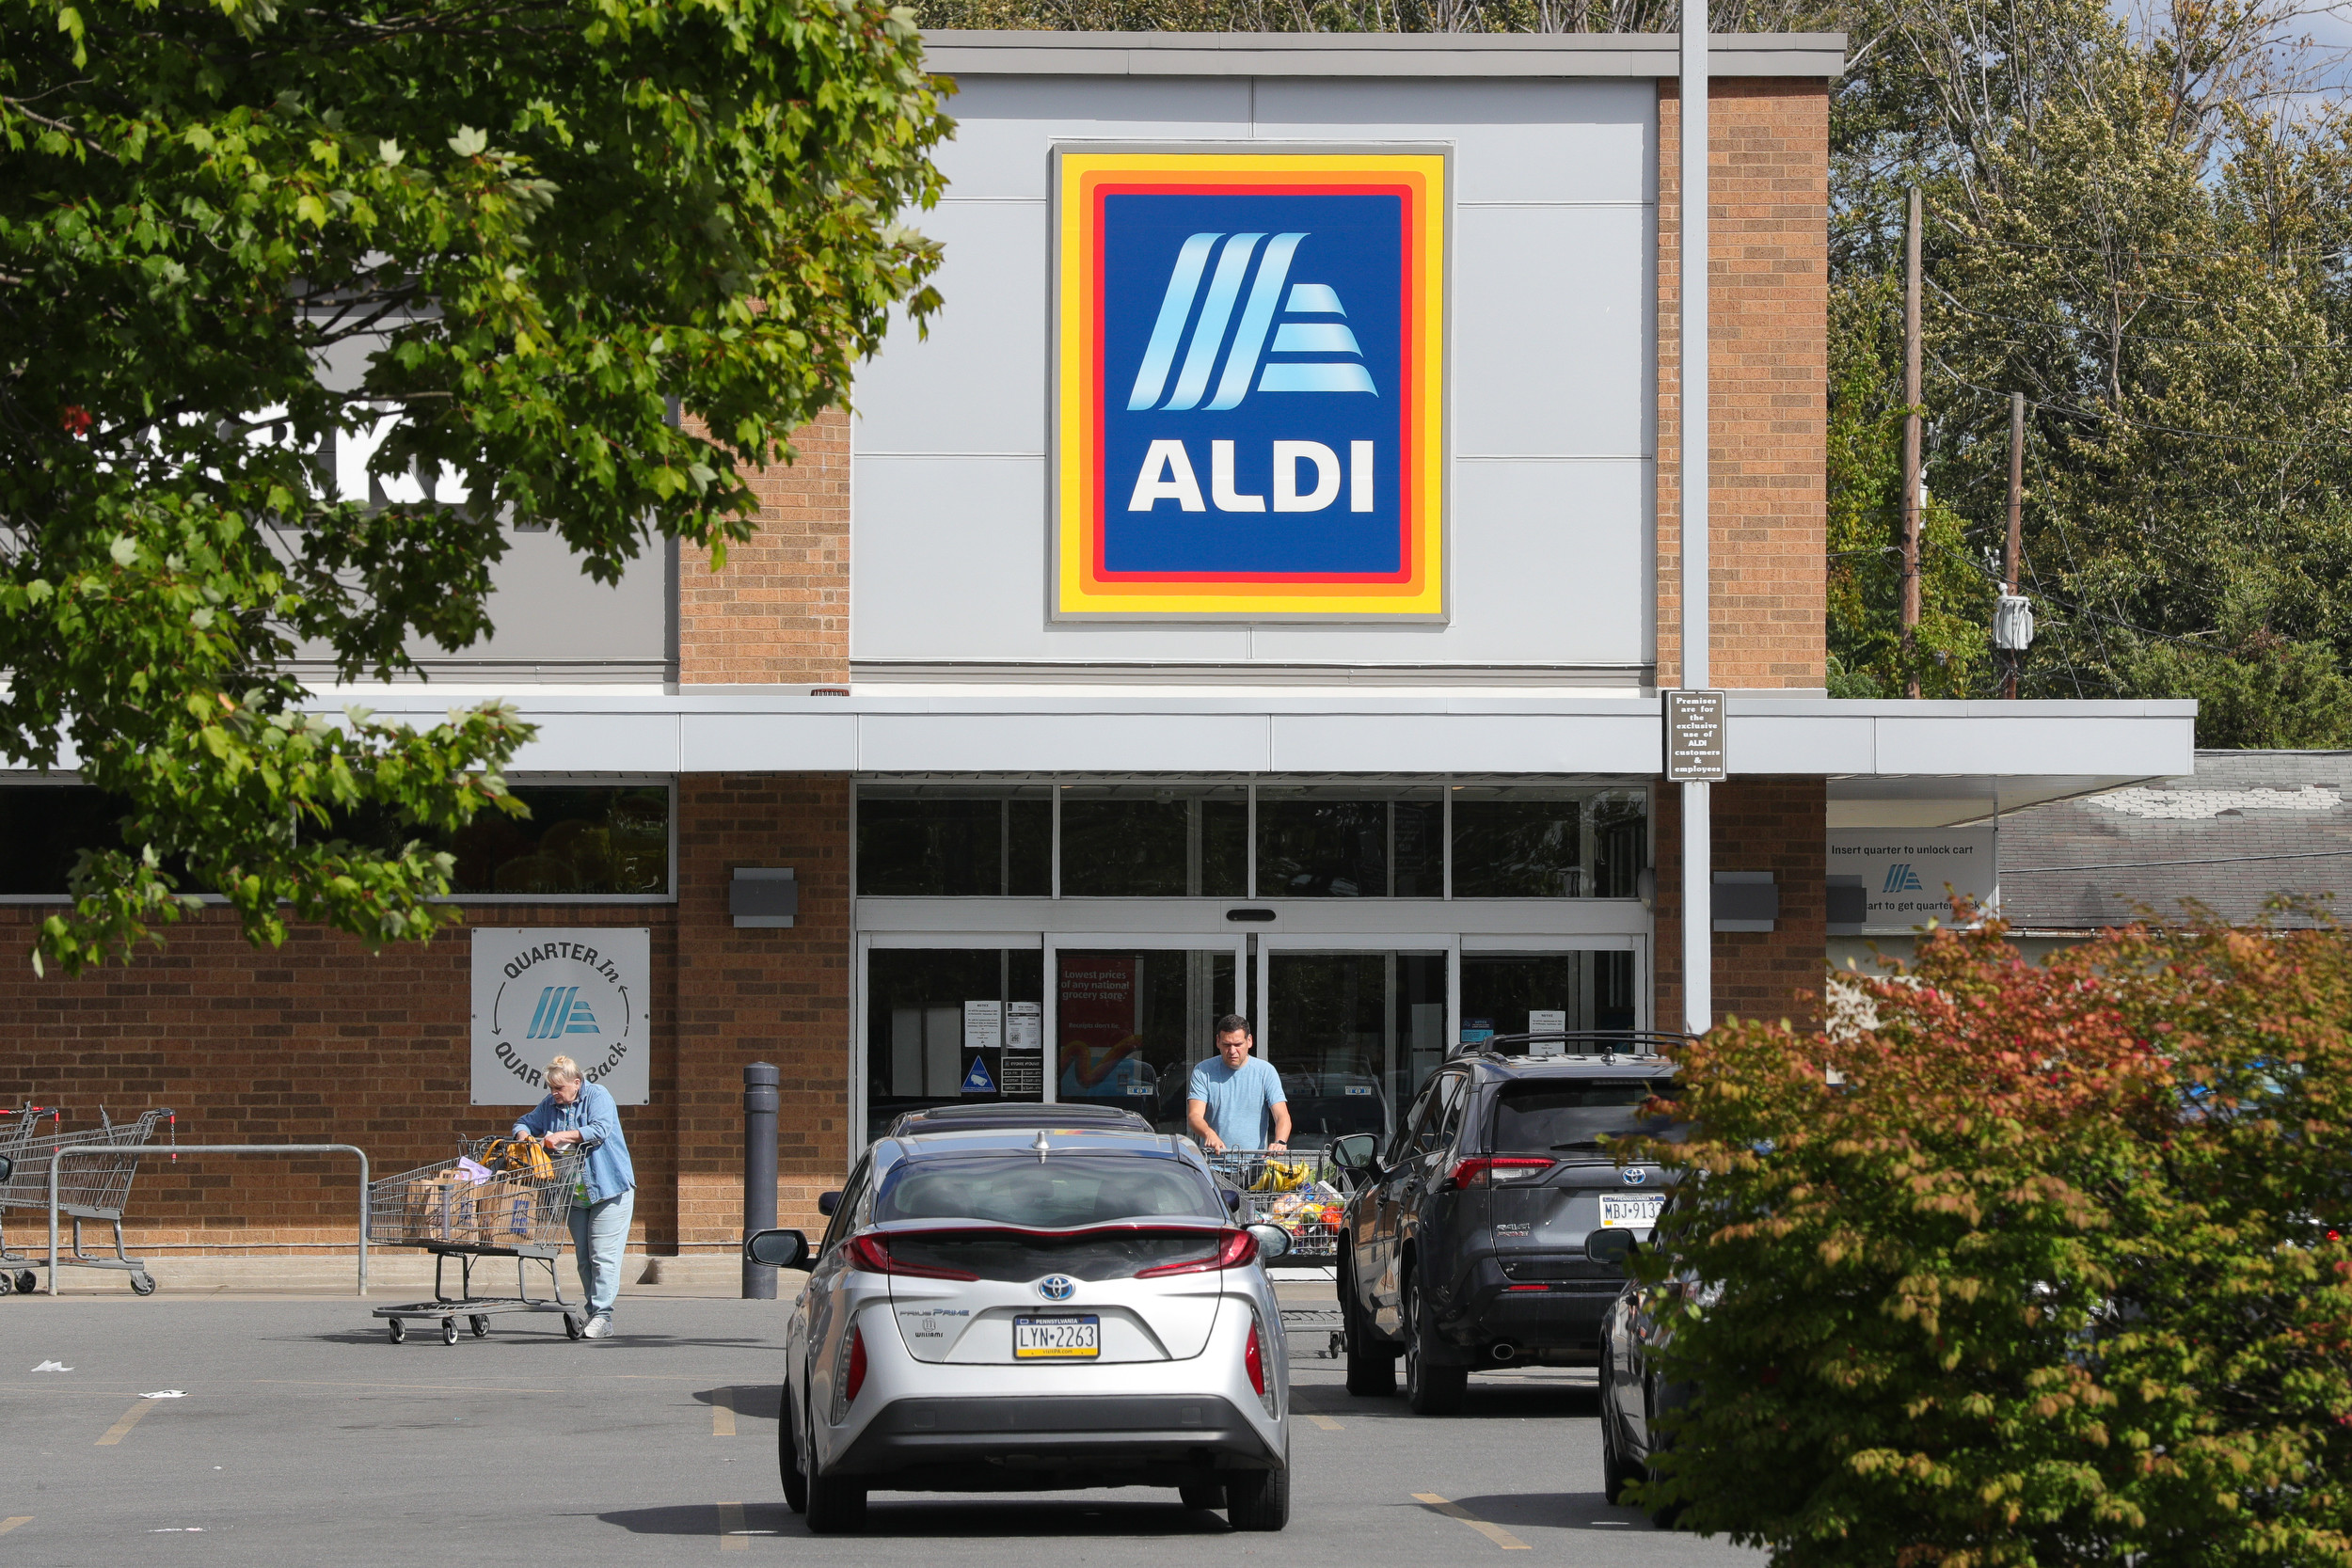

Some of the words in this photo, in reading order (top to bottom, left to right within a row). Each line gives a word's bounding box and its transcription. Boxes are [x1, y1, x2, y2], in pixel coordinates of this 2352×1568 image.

[1127, 439, 1374, 513] ALDI
[1832, 846, 1861, 854] Insert
[1864, 846, 1901, 857] quarter
[1904, 846, 1914, 854] to
[1916, 846, 1950, 854] unlock
[1952, 846, 1974, 854] cart
[1867, 902, 1882, 911] art
[1884, 902, 1895, 911] to
[1898, 902, 1914, 911] get
[503, 942, 598, 979] QUARTER
[596, 958, 619, 984] In
[1099, 970, 1126, 981] prices
[1061, 980, 1071, 989] of
[1073, 982, 1089, 990] any
[1091, 980, 1129, 990] national
[1062, 991, 1097, 1001] grocery
[495, 1041, 548, 1089] QUAR
[584, 1041, 628, 1084] Back
